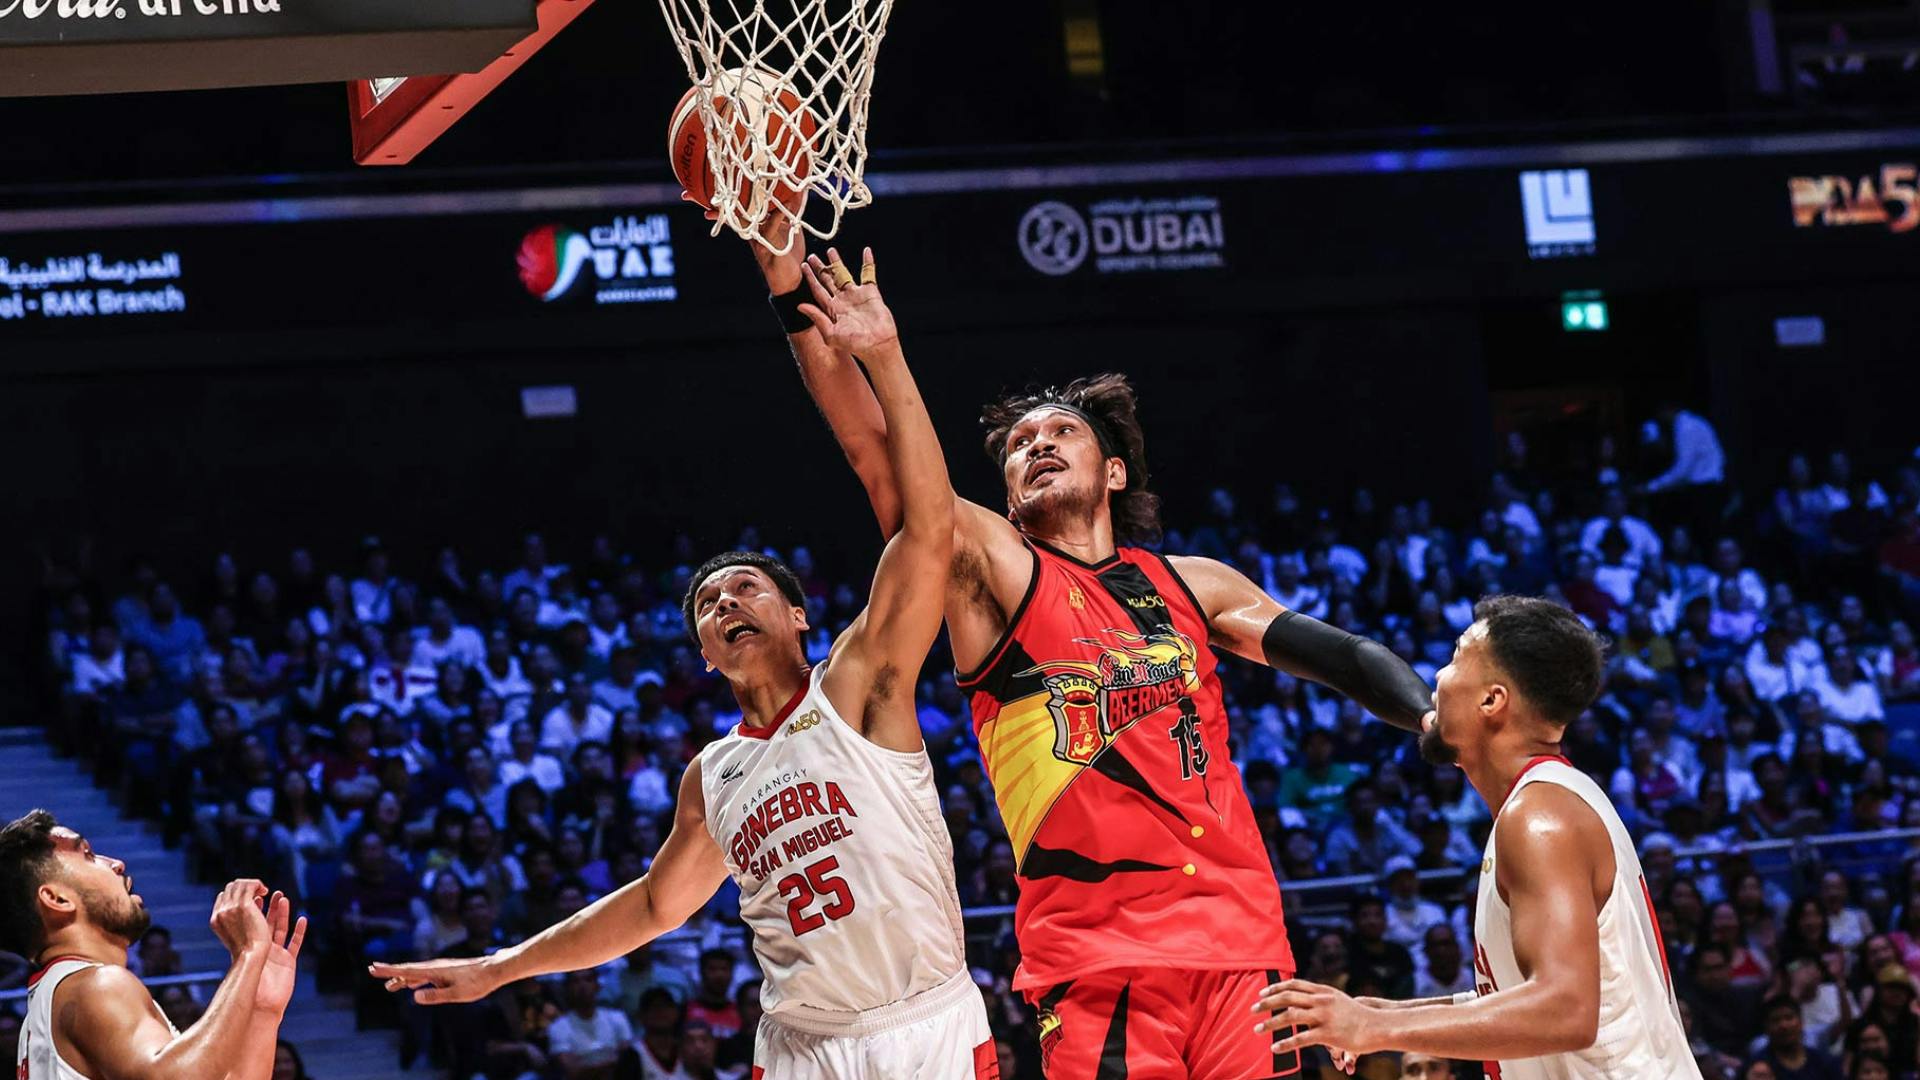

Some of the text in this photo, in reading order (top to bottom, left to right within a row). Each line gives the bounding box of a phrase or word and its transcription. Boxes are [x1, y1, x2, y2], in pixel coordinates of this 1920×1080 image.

[594, 245, 675, 279] UAE
[1092, 212, 1224, 254] DUBAI
[1169, 713, 1209, 781] 15
[742, 768, 808, 814] BARANGAY
[731, 781, 858, 874] GINEBRA
[750, 816, 853, 881] SAN MIGUEL
[777, 855, 855, 937] 25
